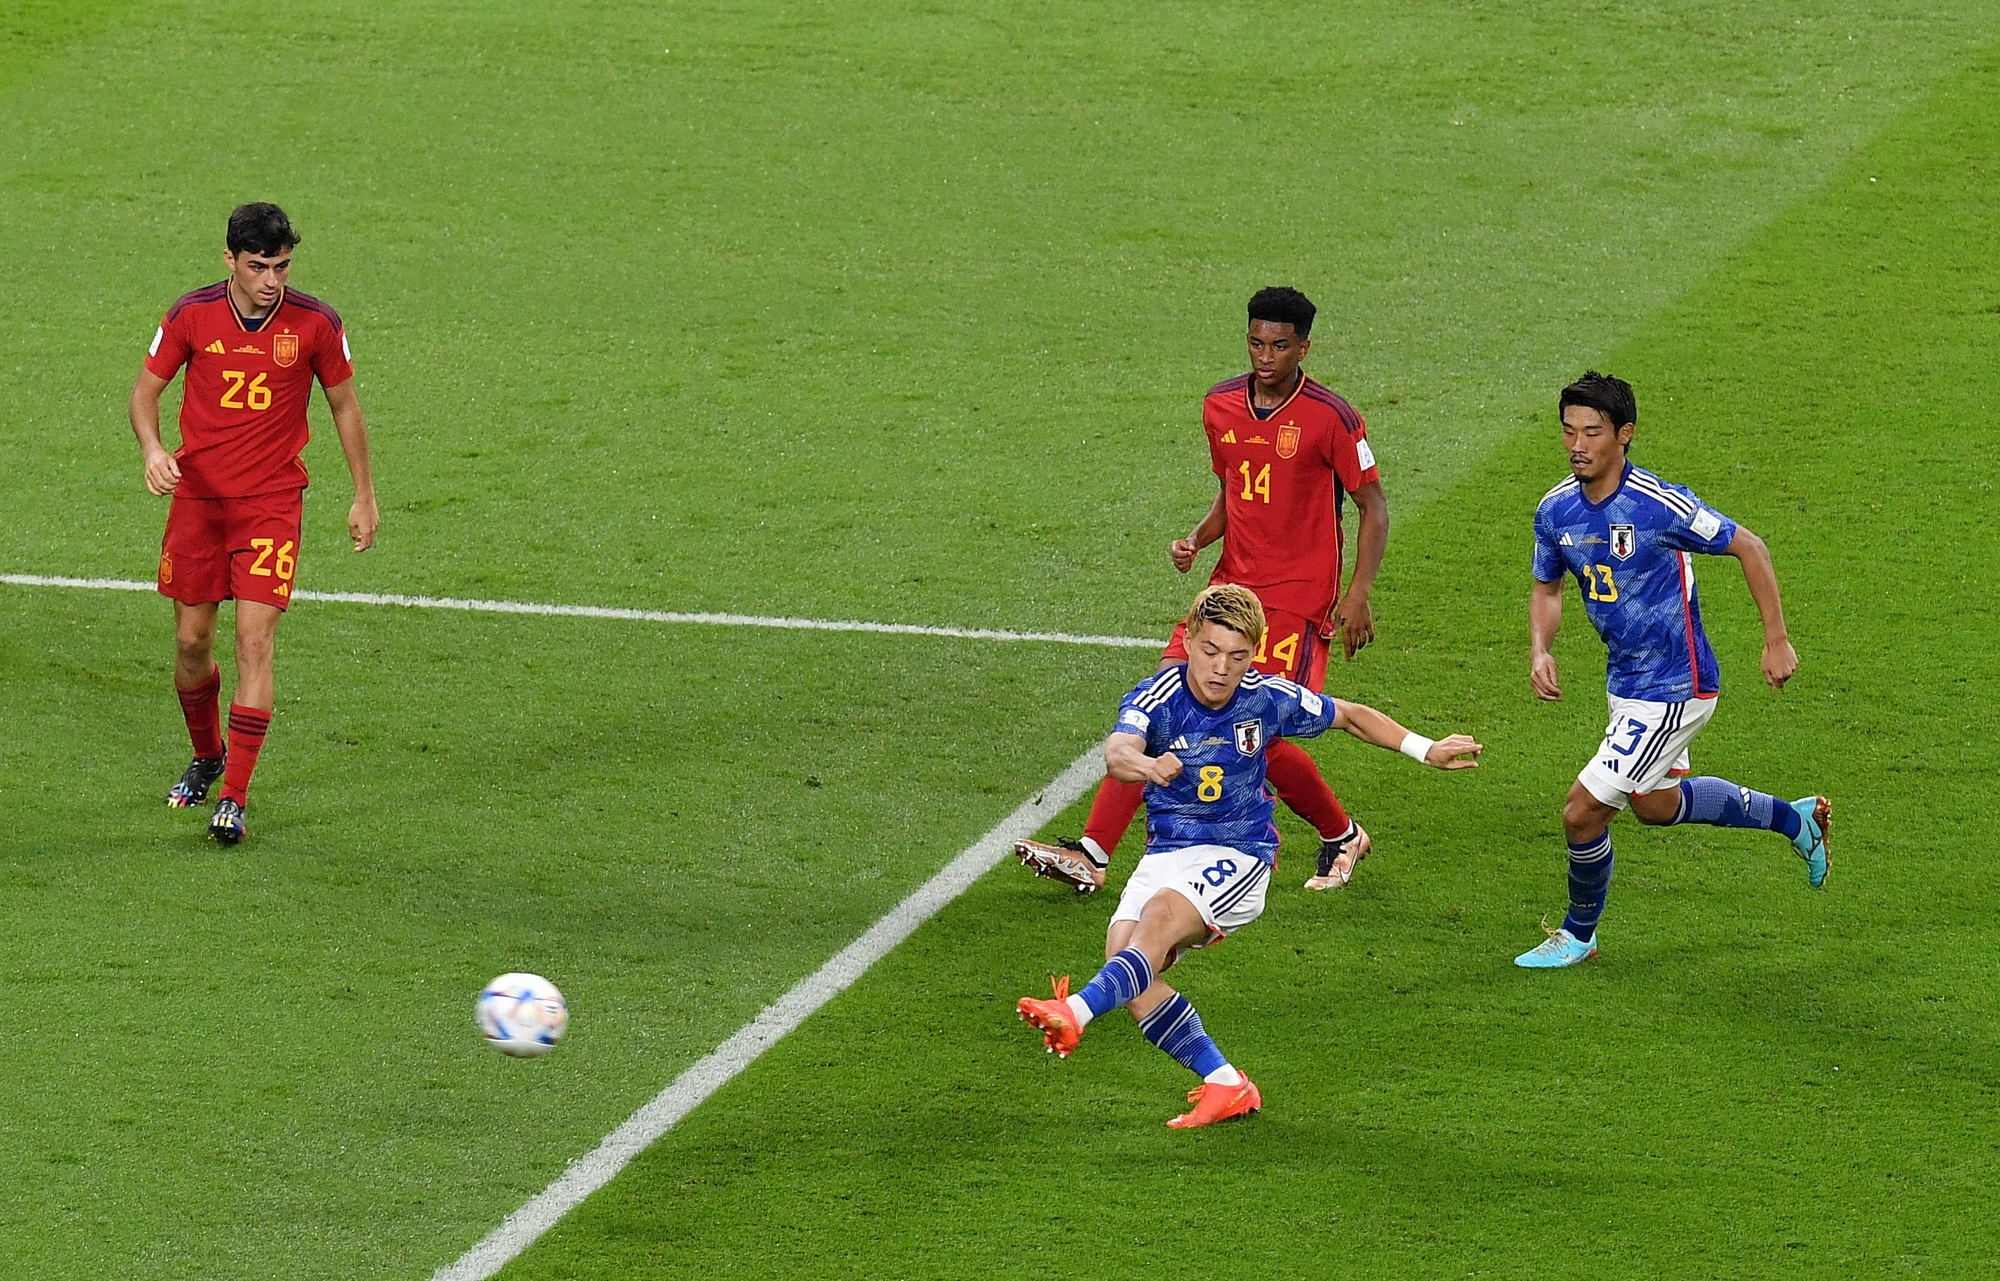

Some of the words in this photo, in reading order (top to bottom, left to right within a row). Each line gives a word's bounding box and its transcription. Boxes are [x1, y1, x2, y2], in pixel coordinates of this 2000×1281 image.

[220, 370, 272, 410] 26
[1239, 460, 1271, 504] 14
[249, 538, 295, 580] 26
[1583, 564, 1619, 603] 13
[1253, 626, 1299, 671] 14
[1197, 765, 1224, 802] 8
[1201, 859, 1237, 887] 8
